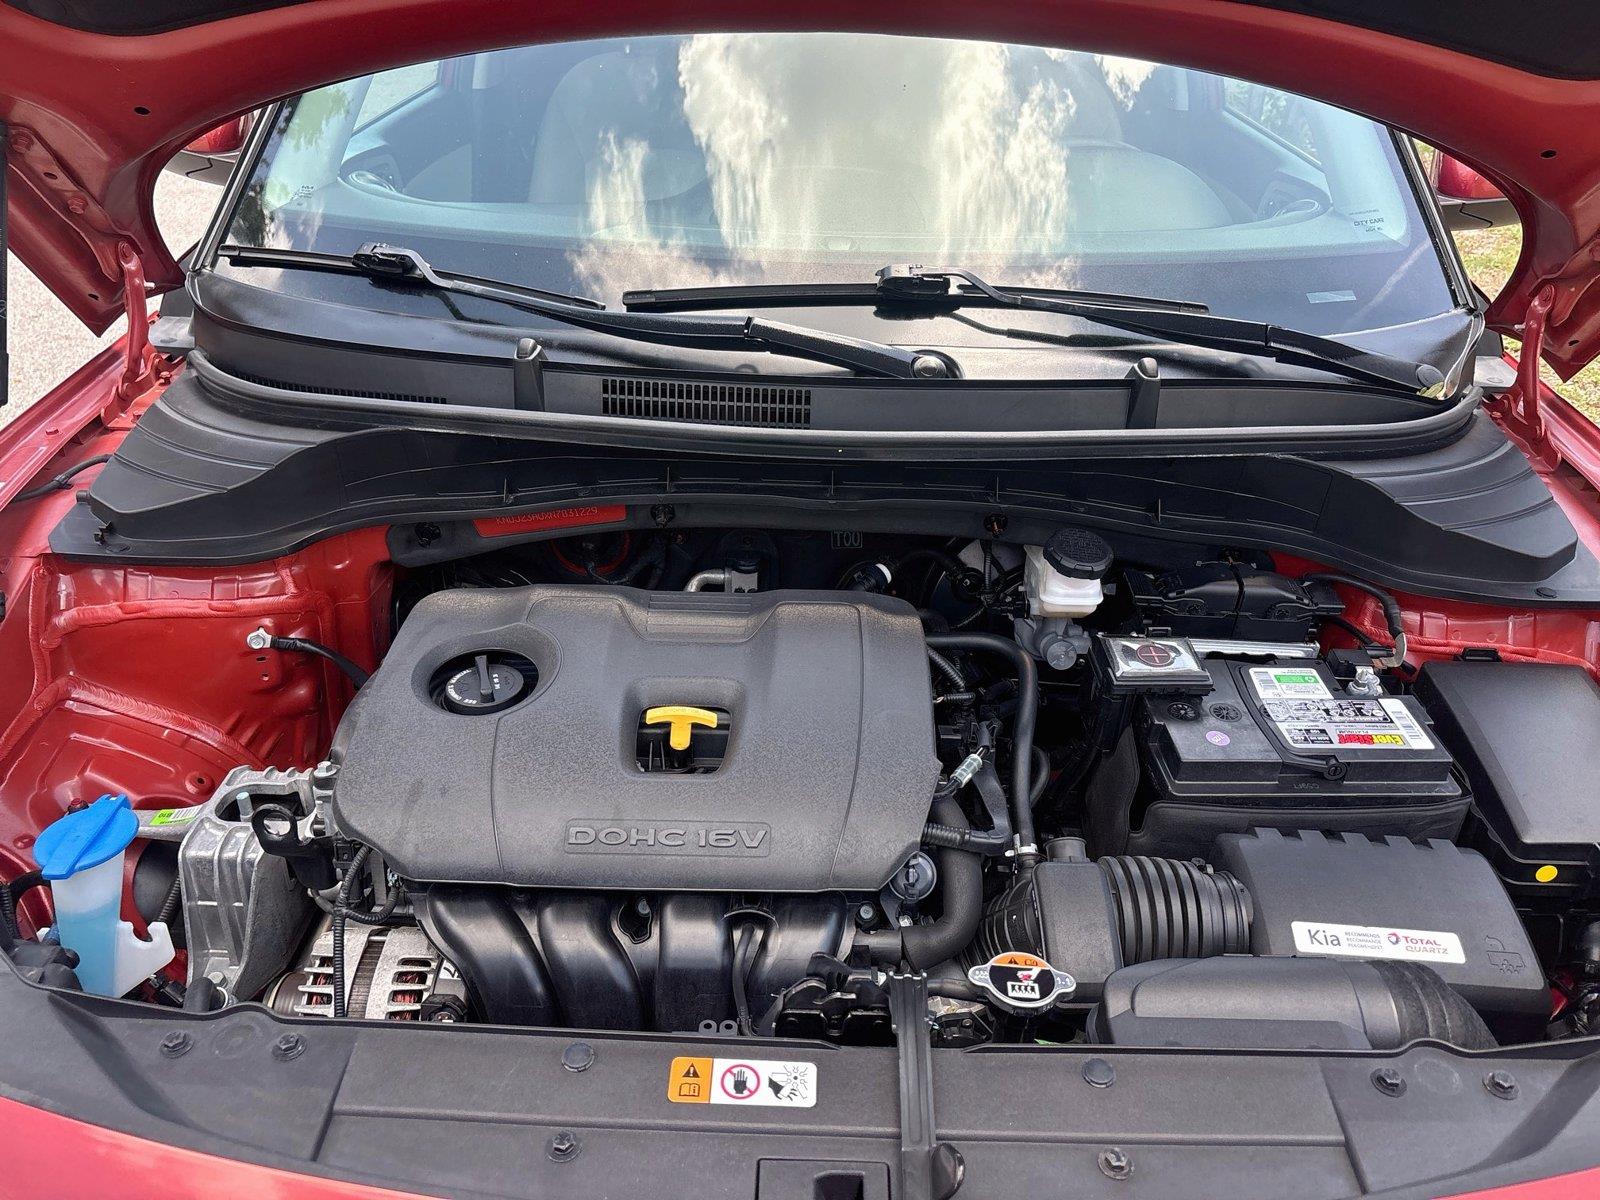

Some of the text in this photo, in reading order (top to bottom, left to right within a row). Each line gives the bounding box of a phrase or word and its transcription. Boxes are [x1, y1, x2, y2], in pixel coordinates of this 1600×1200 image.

[567, 827, 768, 849] DOHC 16V
[1308, 929, 1342, 947] Kia
[1402, 935, 1442, 947] TOTAL
[1405, 945, 1449, 955] QUARTZ
